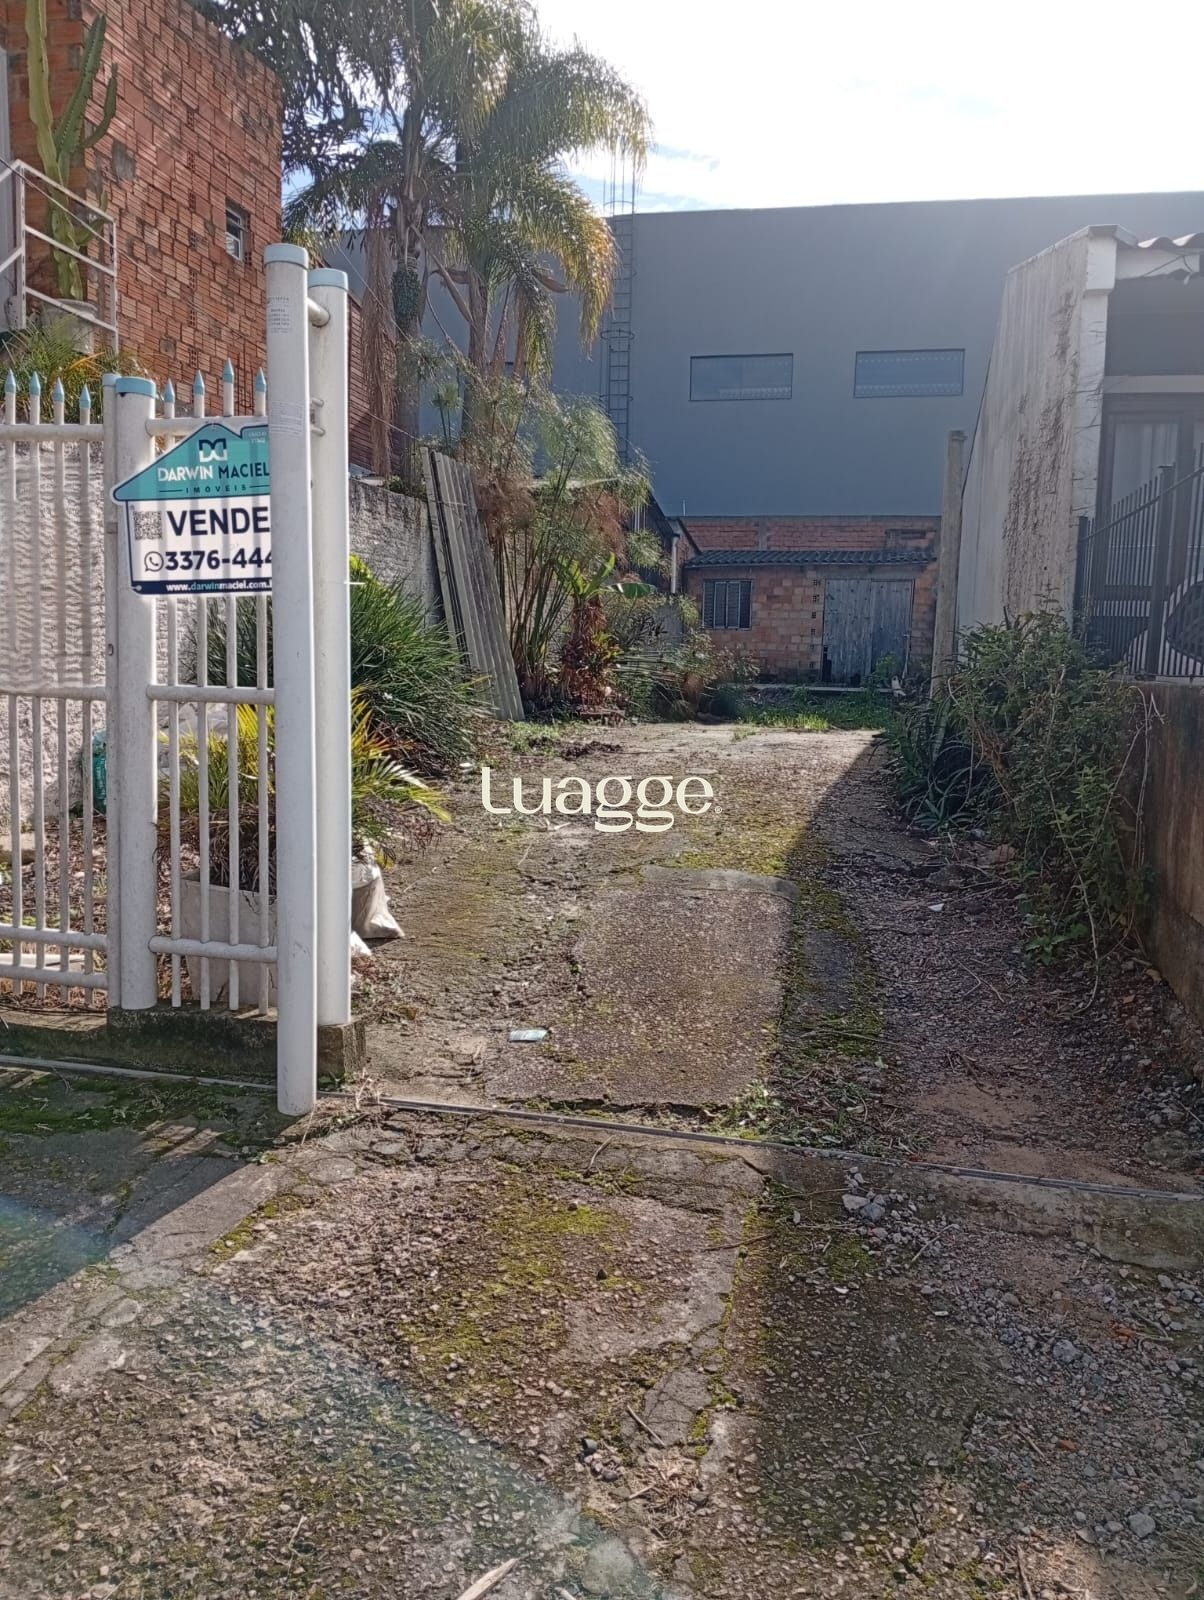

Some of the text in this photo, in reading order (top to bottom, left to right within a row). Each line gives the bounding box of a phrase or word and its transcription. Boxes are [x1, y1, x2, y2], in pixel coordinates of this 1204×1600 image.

[157, 462, 270, 482] DARWIN MACIEL
[167, 506, 270, 537] VENDE
